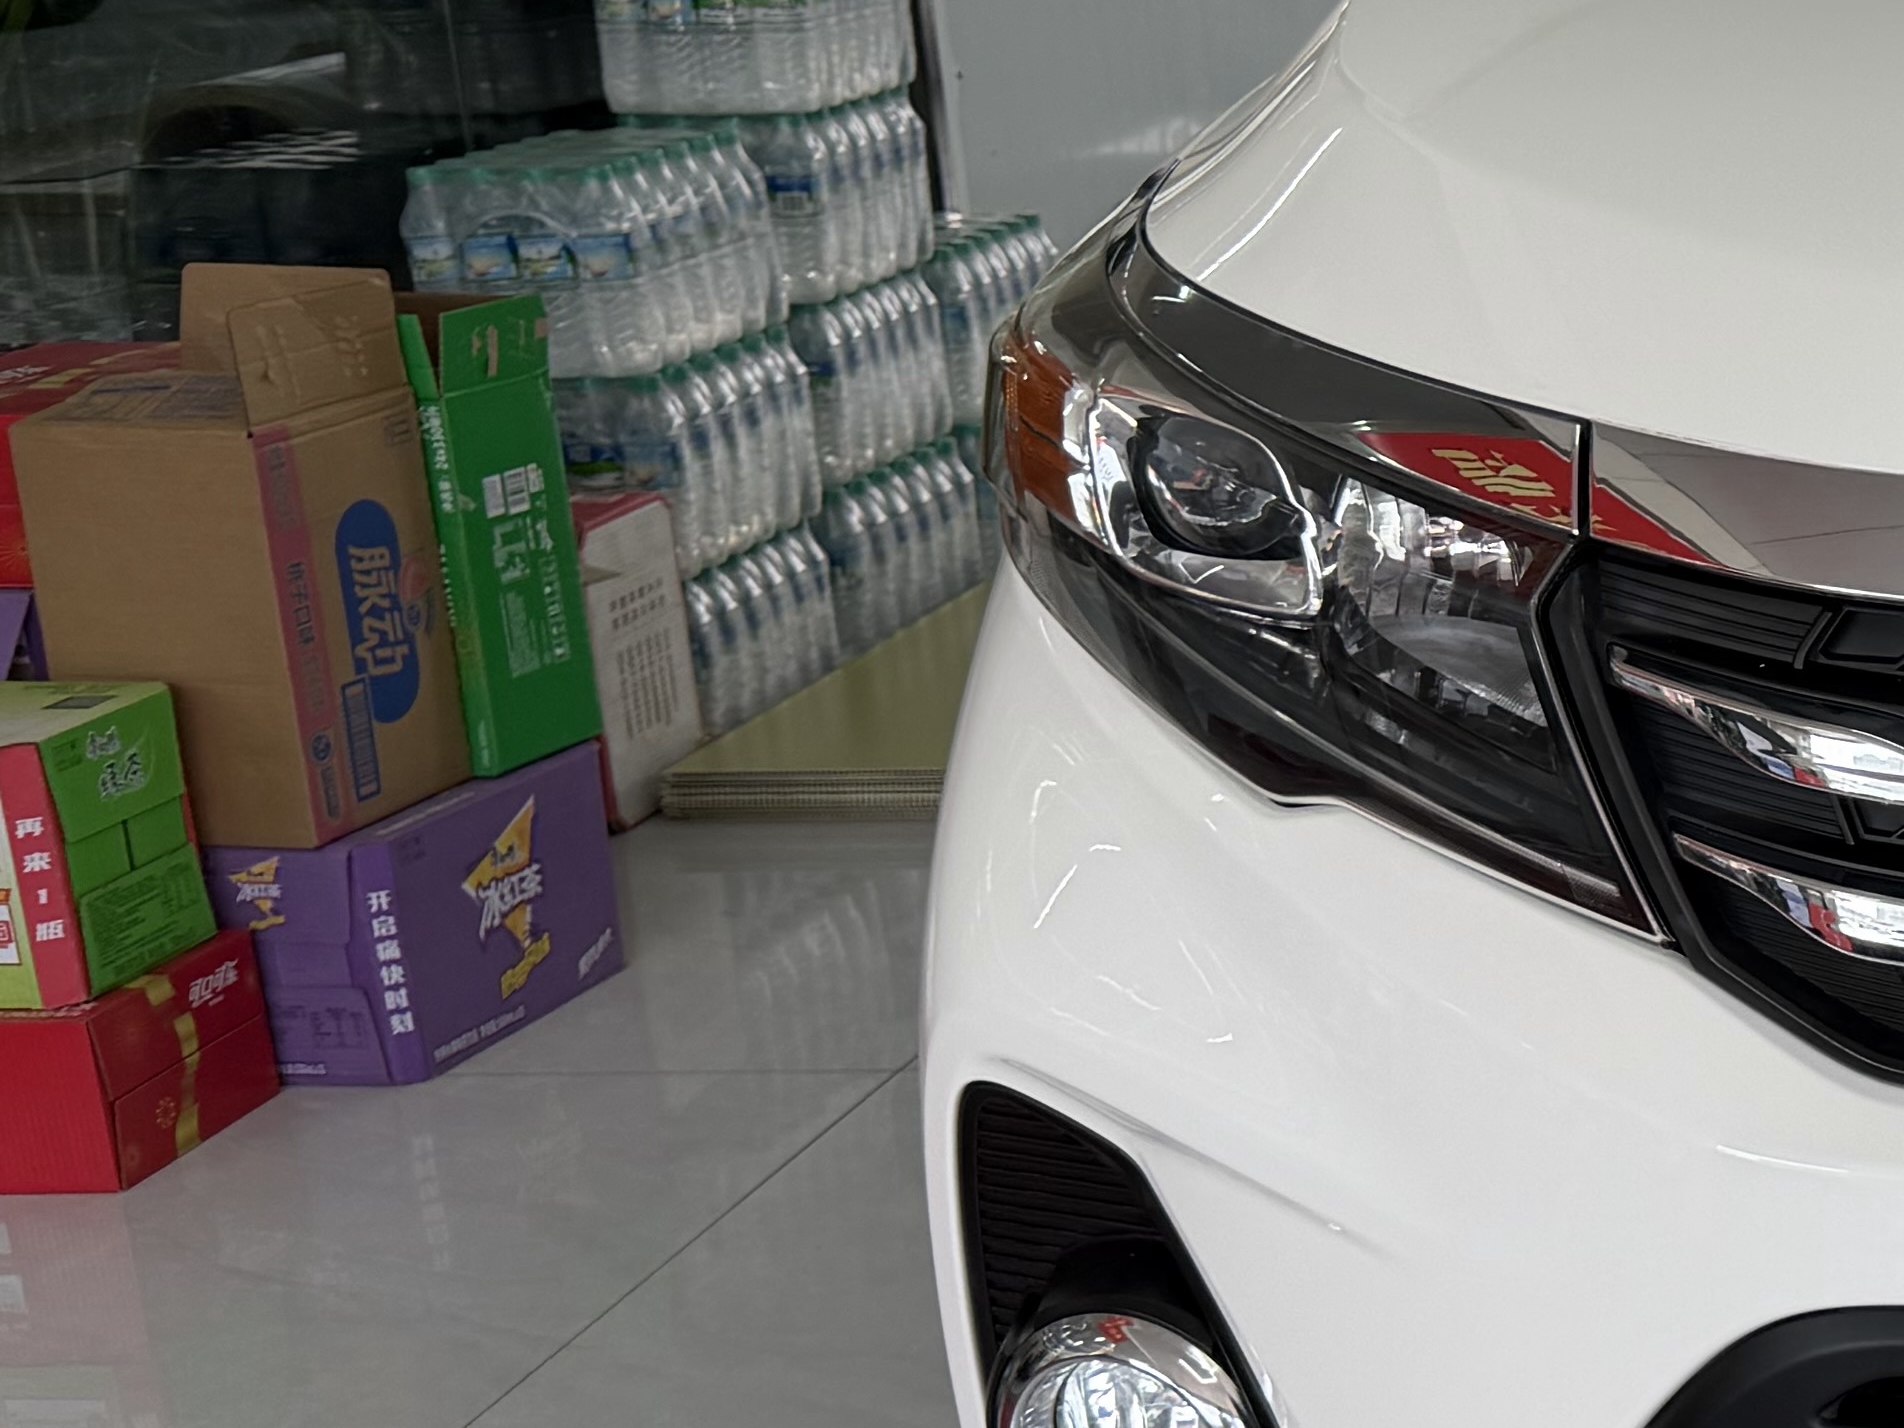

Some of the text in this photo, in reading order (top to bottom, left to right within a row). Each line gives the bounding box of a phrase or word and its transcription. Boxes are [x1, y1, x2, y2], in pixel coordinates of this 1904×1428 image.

[346, 542, 413, 678] 脉动
[15, 815, 66, 943] 再来1瓶
[366, 889, 416, 1037] 开启痛快时刻
